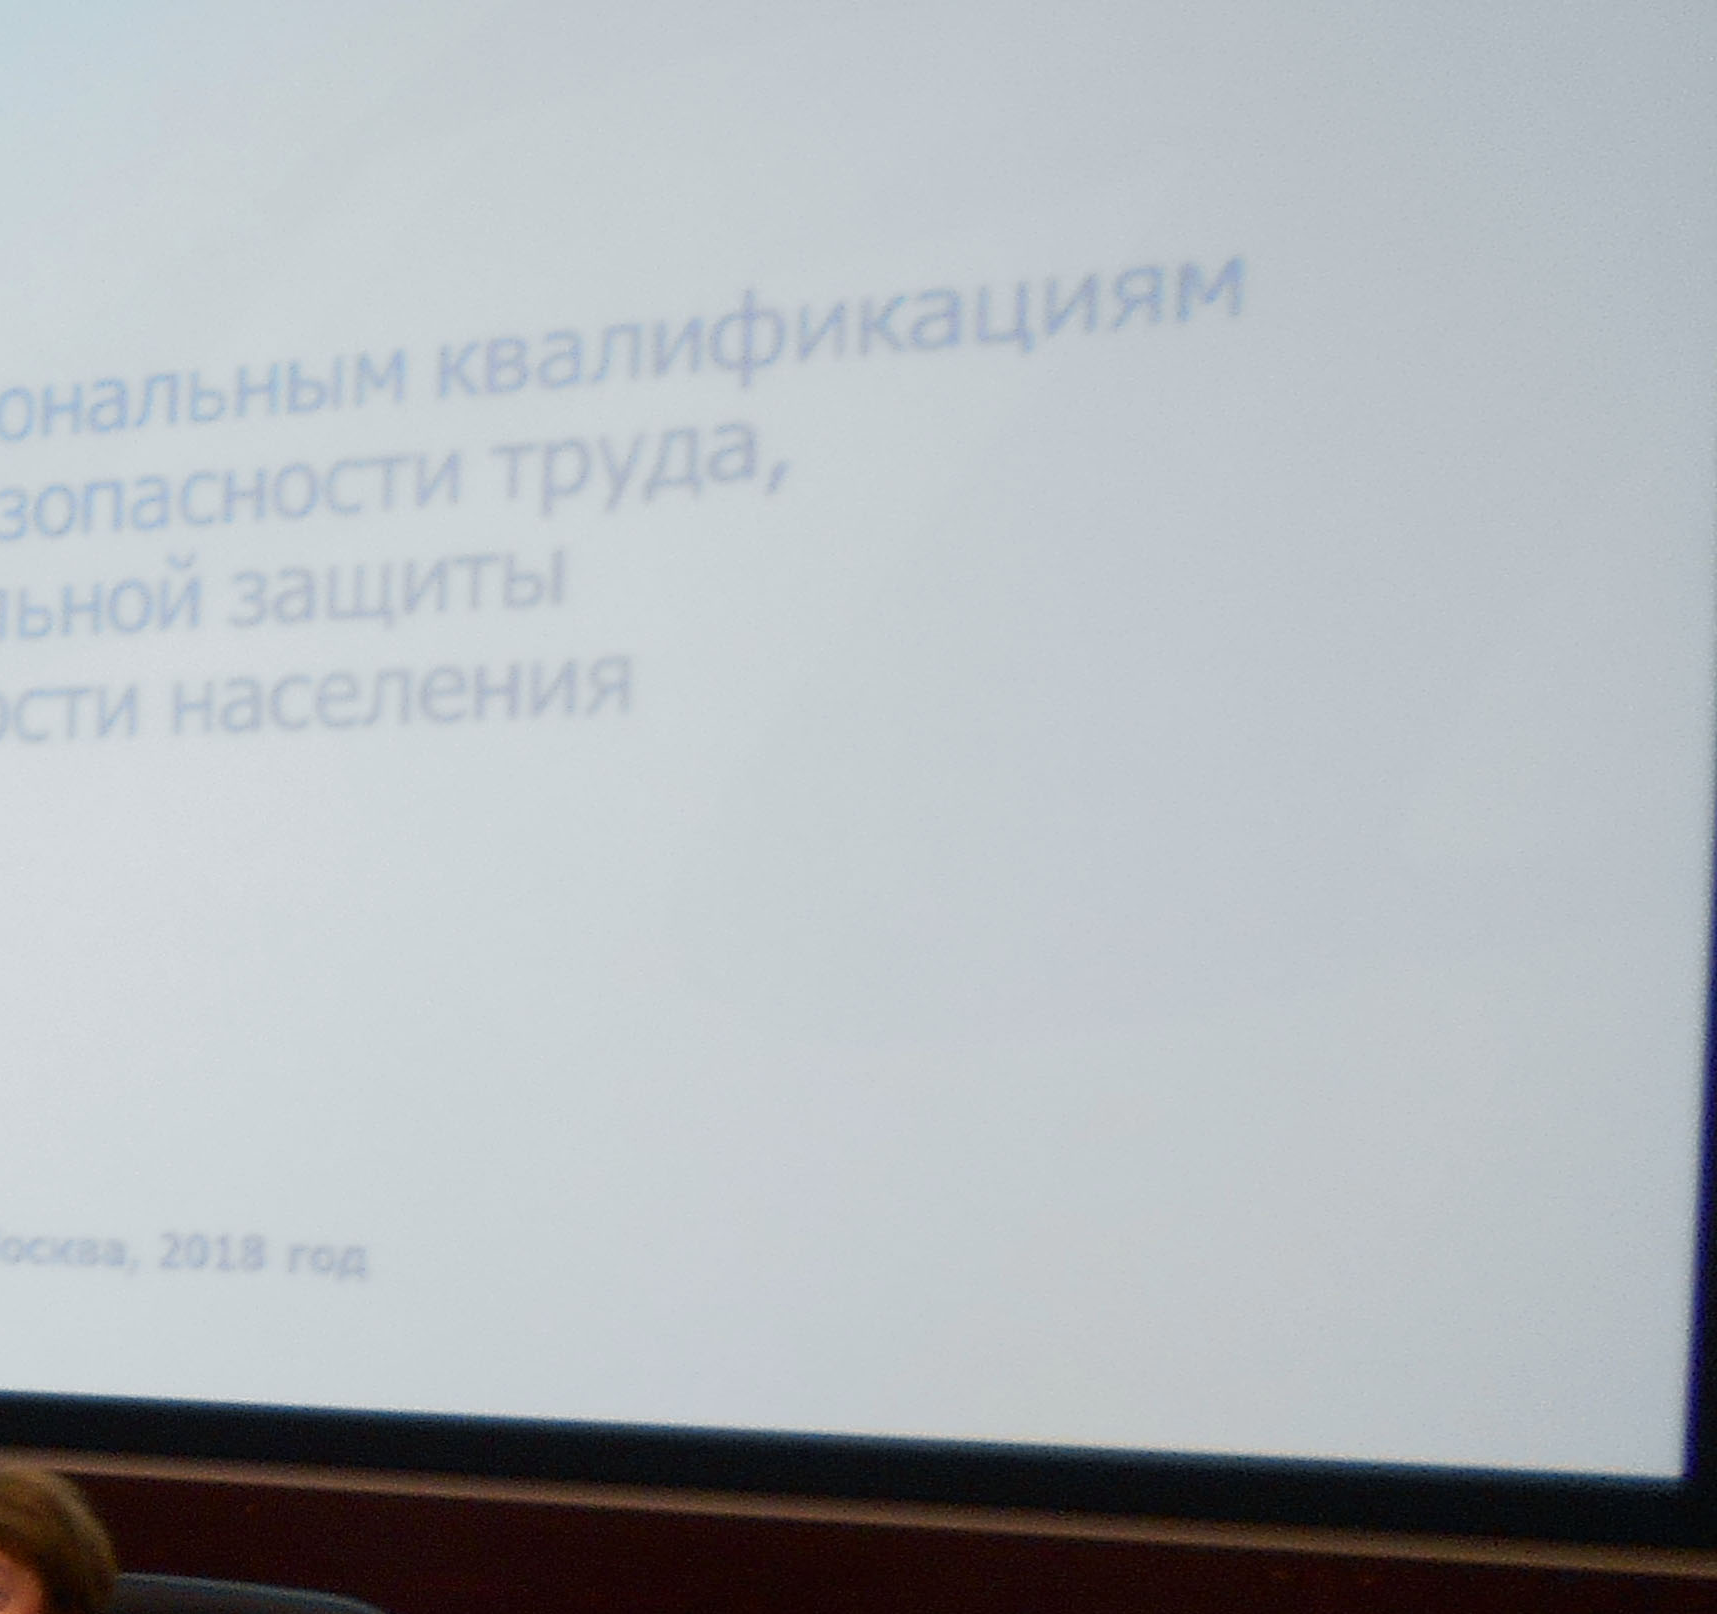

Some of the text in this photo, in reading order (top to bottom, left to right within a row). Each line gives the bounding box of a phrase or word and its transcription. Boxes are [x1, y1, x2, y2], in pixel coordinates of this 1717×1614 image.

[433, 254, 1247, 400] квалификациям
[489, 418, 792, 516] труда,
[228, 548, 569, 630] защиты
[171, 653, 635, 738] населения
[158, 1231, 267, 1273] 2018
[287, 1242, 369, 1281] год
